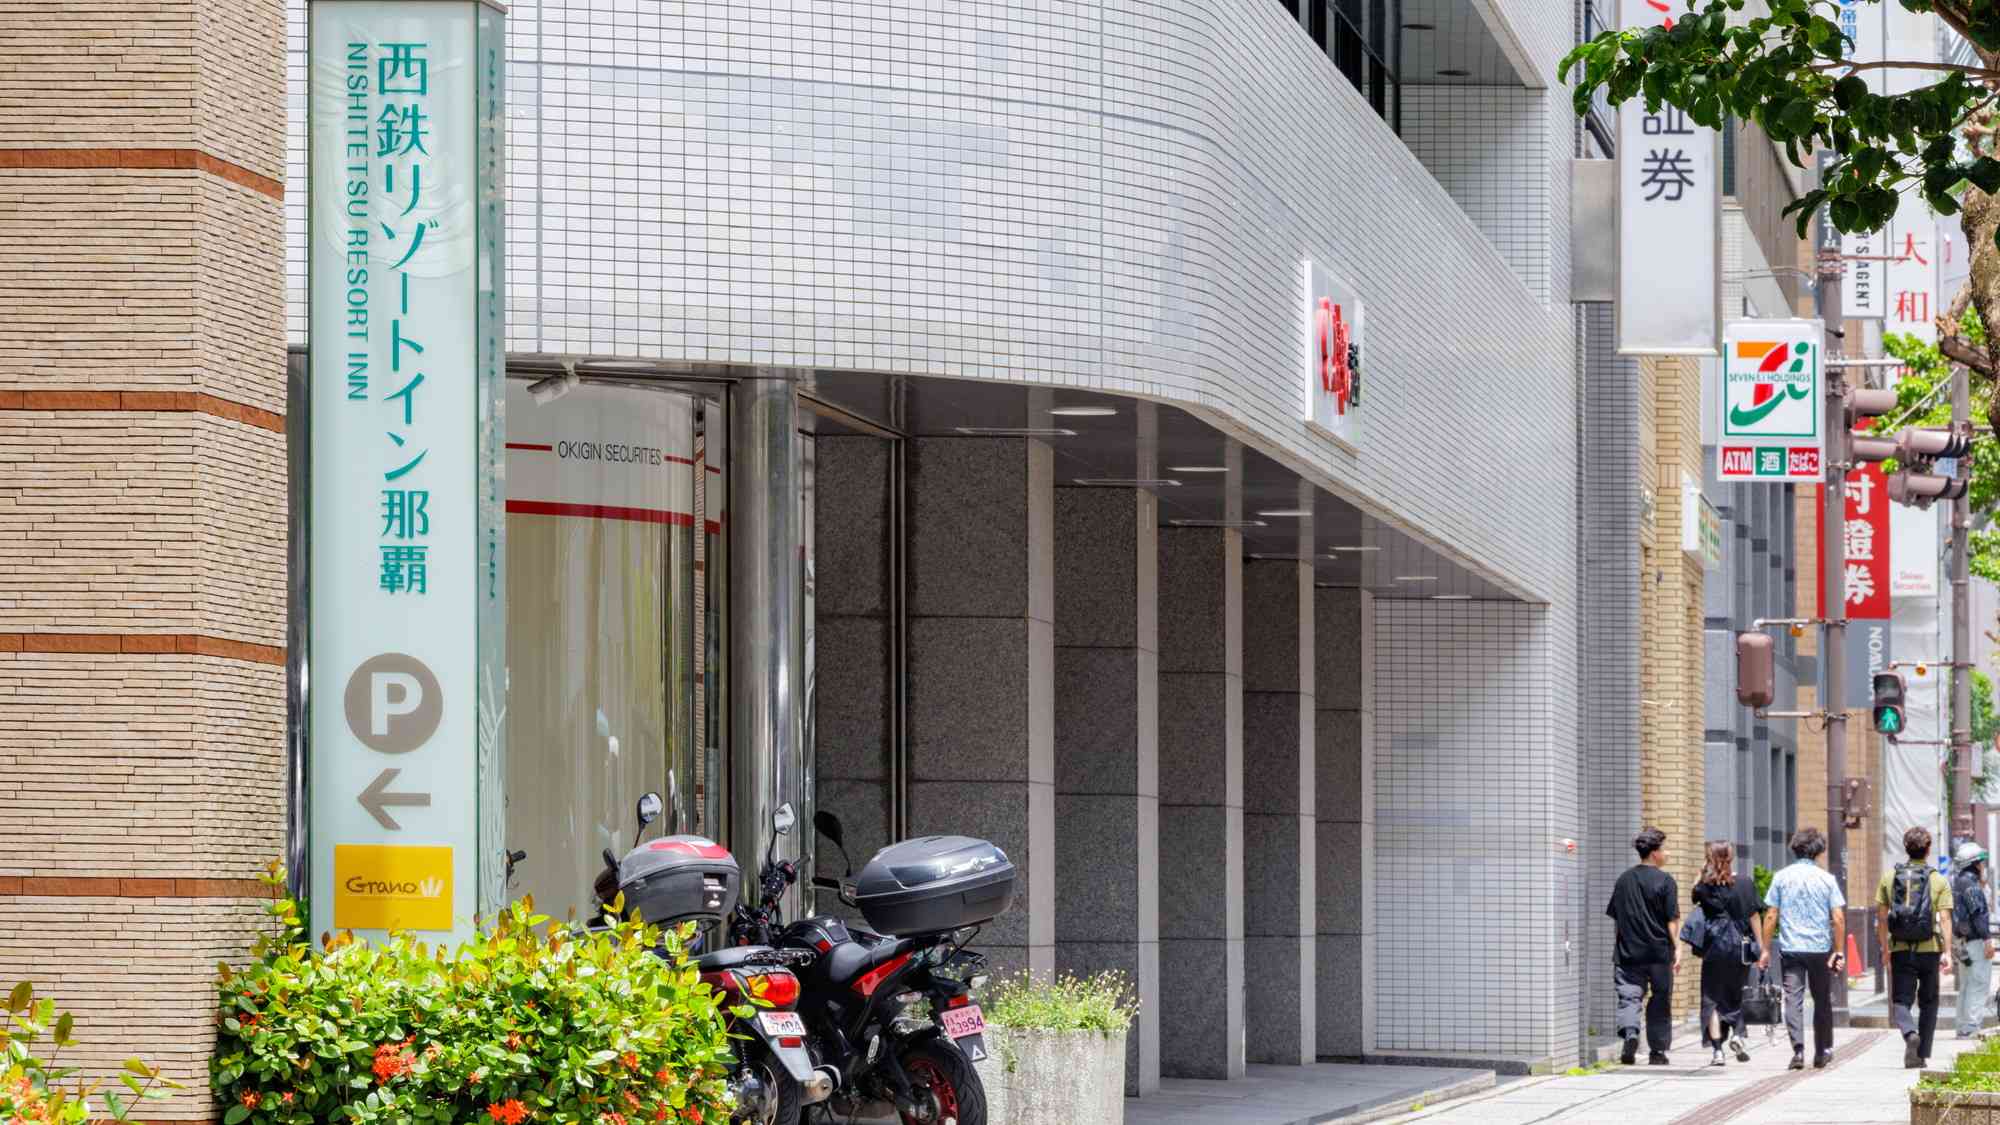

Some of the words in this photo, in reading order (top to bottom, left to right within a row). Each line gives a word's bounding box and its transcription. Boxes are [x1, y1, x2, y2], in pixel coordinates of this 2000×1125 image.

[347, 42, 369, 217] NISHITETSU
[347, 229, 369, 341] RESORT
[1856, 262, 1870, 309] AGENT
[376, 42, 440, 594] 西鉄リゾートイン那覇
[347, 353, 369, 400] INN
[558, 440, 602, 460] OKIGIN
[605, 443, 662, 466] SECURITIES
[1724, 451, 1753, 472] ATM
[1760, 452, 1781, 473] 酒
[1789, 452, 1819, 473] たばこ
[371, 671, 423, 735] P
[345, 876, 417, 894] Grano
